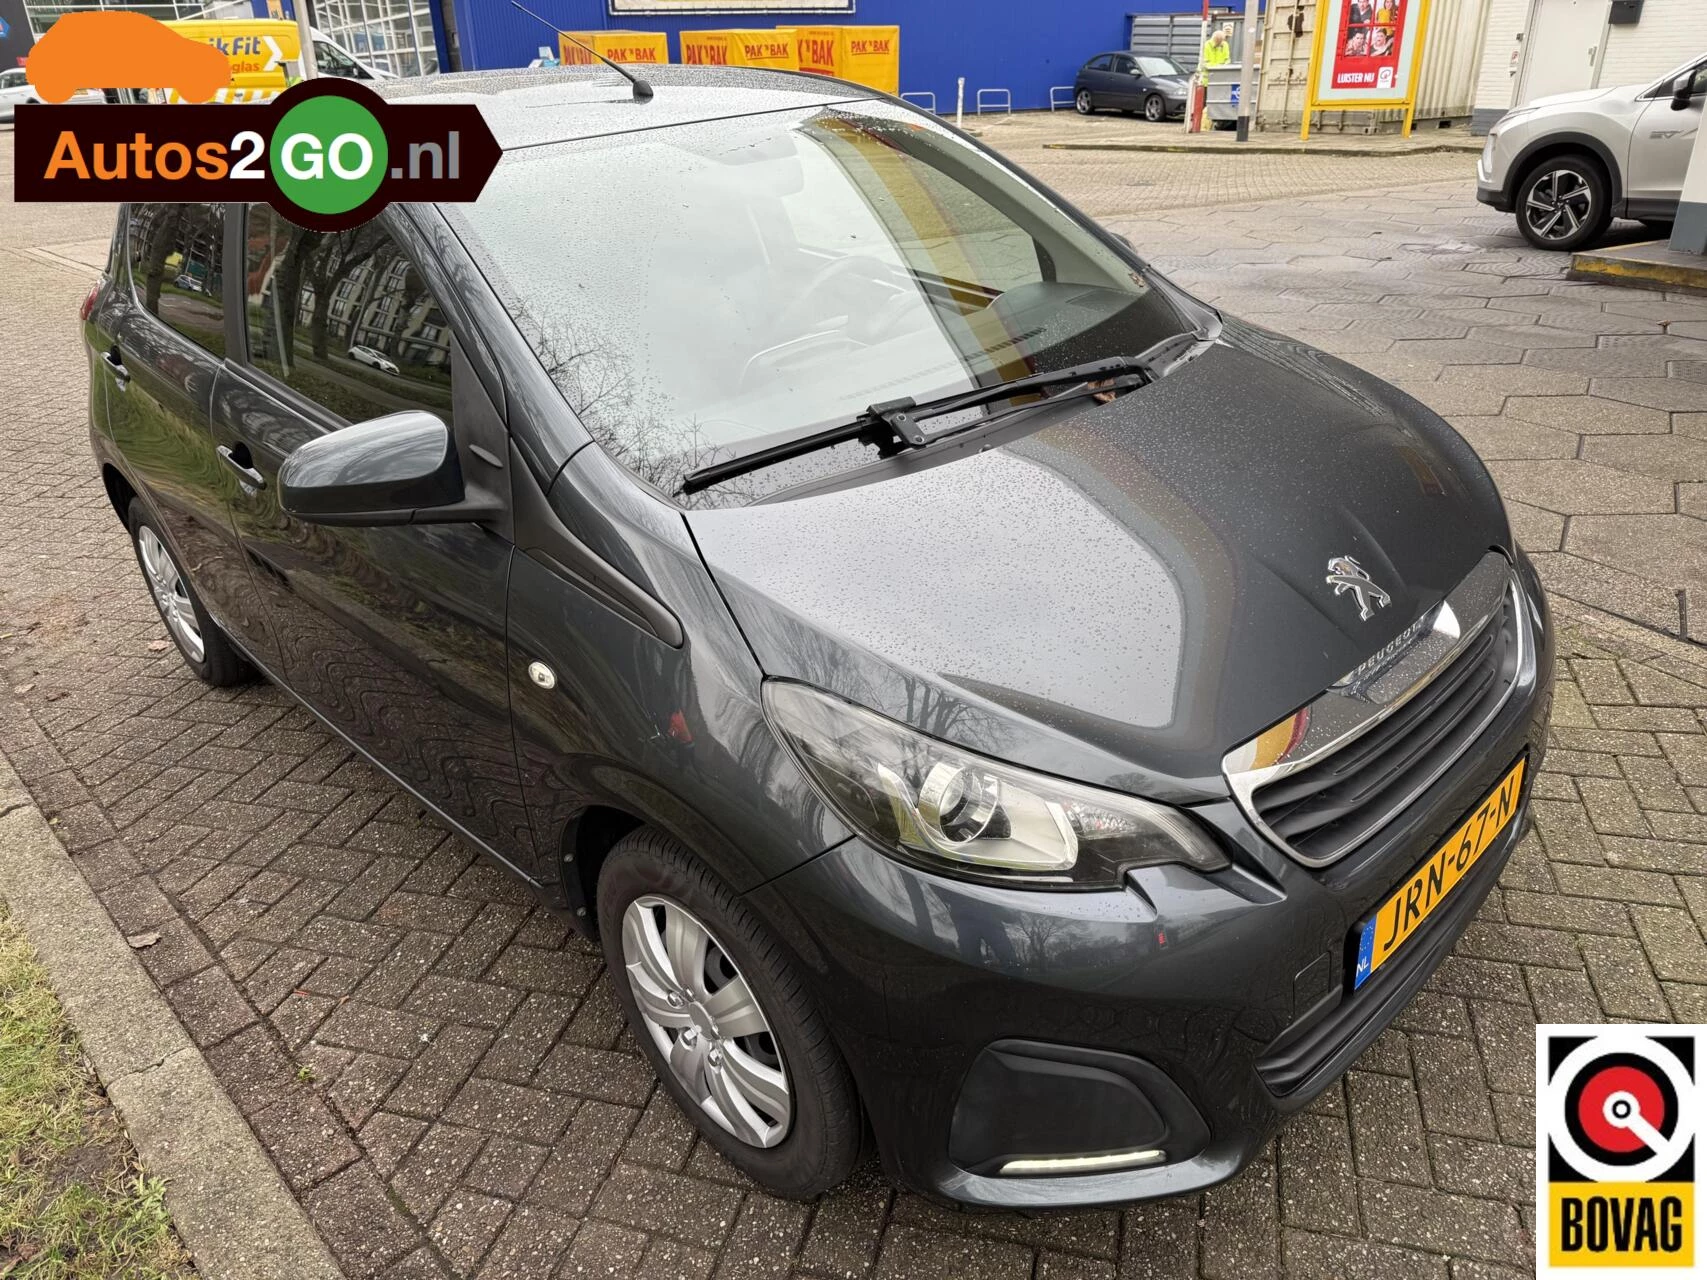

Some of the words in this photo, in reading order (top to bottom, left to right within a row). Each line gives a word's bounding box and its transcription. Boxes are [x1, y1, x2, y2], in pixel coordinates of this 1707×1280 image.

[607, 48, 627, 61] PAK
[635, 47, 656, 61] BAK
[744, 44, 763, 57] PAK
[770, 43, 789, 56] BAK
[812, 39, 834, 67] BAK
[851, 40, 867, 53] PAK
[873, 39, 890, 52] BAK
[1357, 621, 1422, 675] PEUGEOT
[1383, 774, 1515, 951] JRN-67-N
[1356, 956, 1369, 978] NL
